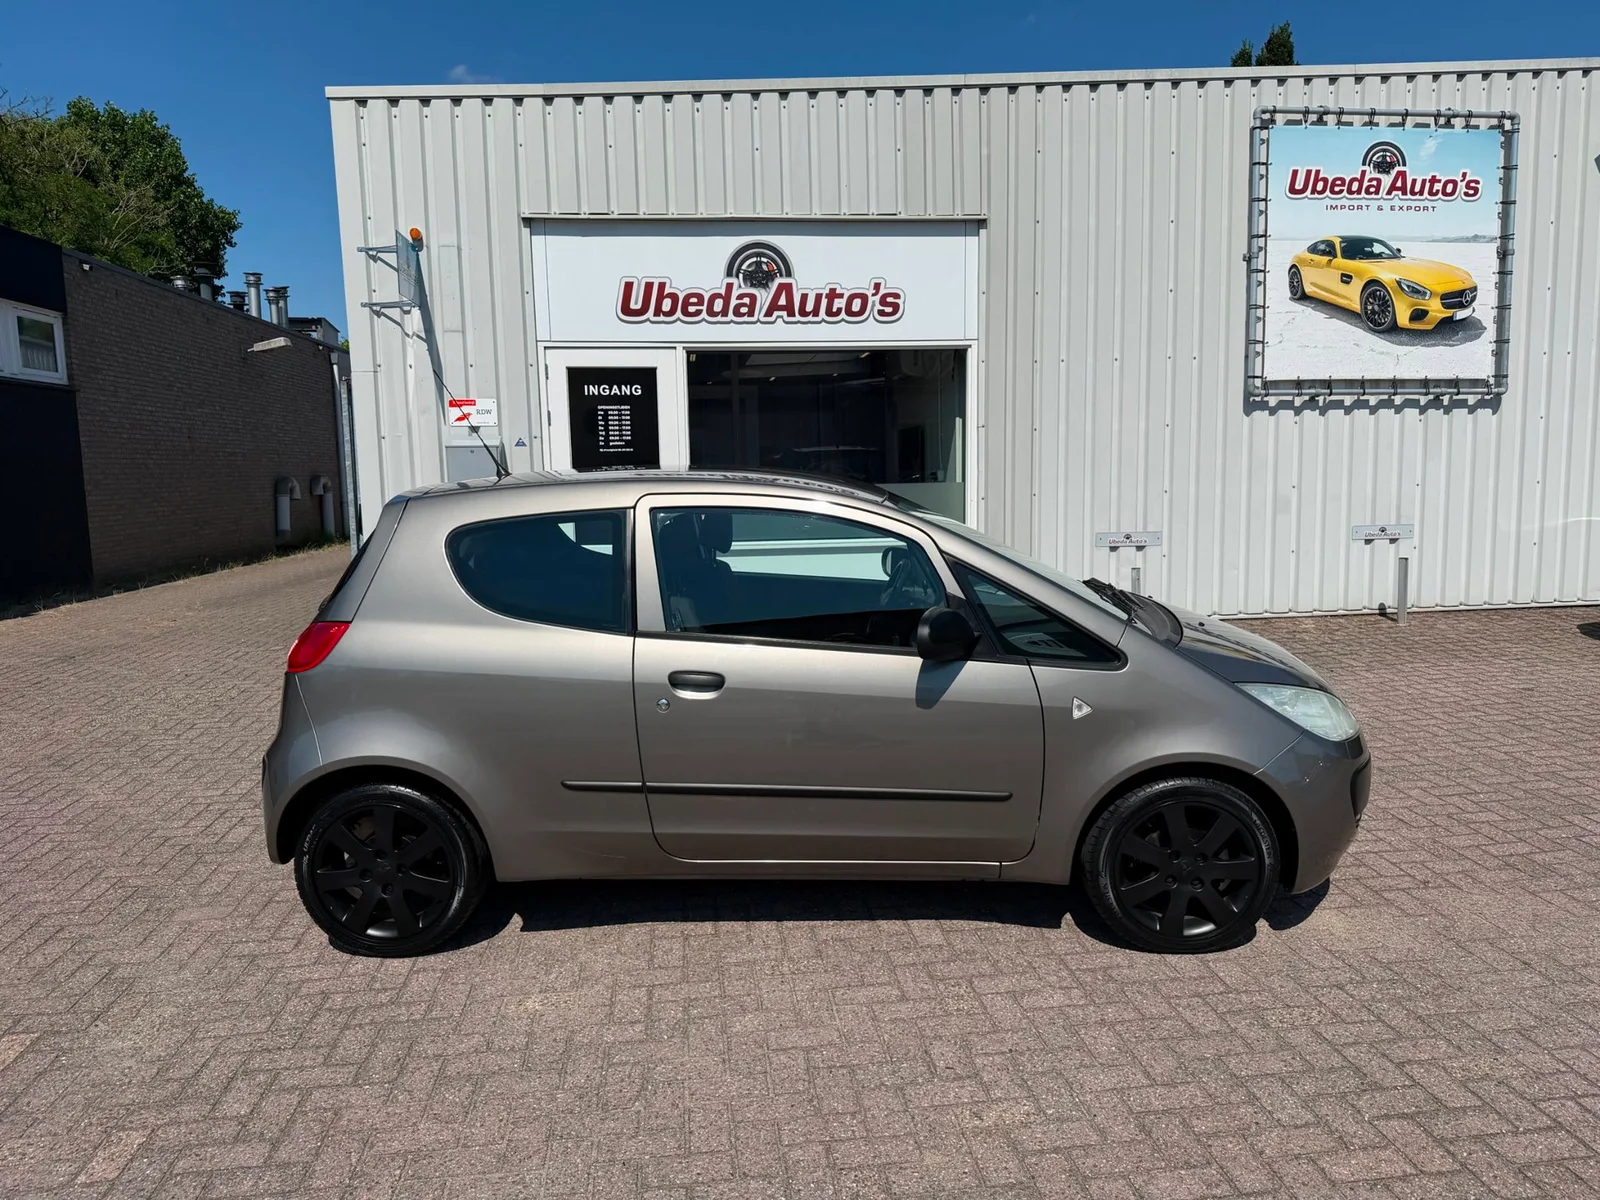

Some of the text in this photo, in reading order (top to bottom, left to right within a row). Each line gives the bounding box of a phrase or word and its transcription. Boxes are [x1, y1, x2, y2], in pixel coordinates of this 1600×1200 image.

[1287, 168, 1481, 198] Ubeda Auto's
[1325, 204, 1438, 213] IMPORT & EXPORT
[619, 280, 902, 319] Ubeda Auto's
[584, 384, 642, 396] INGANG
